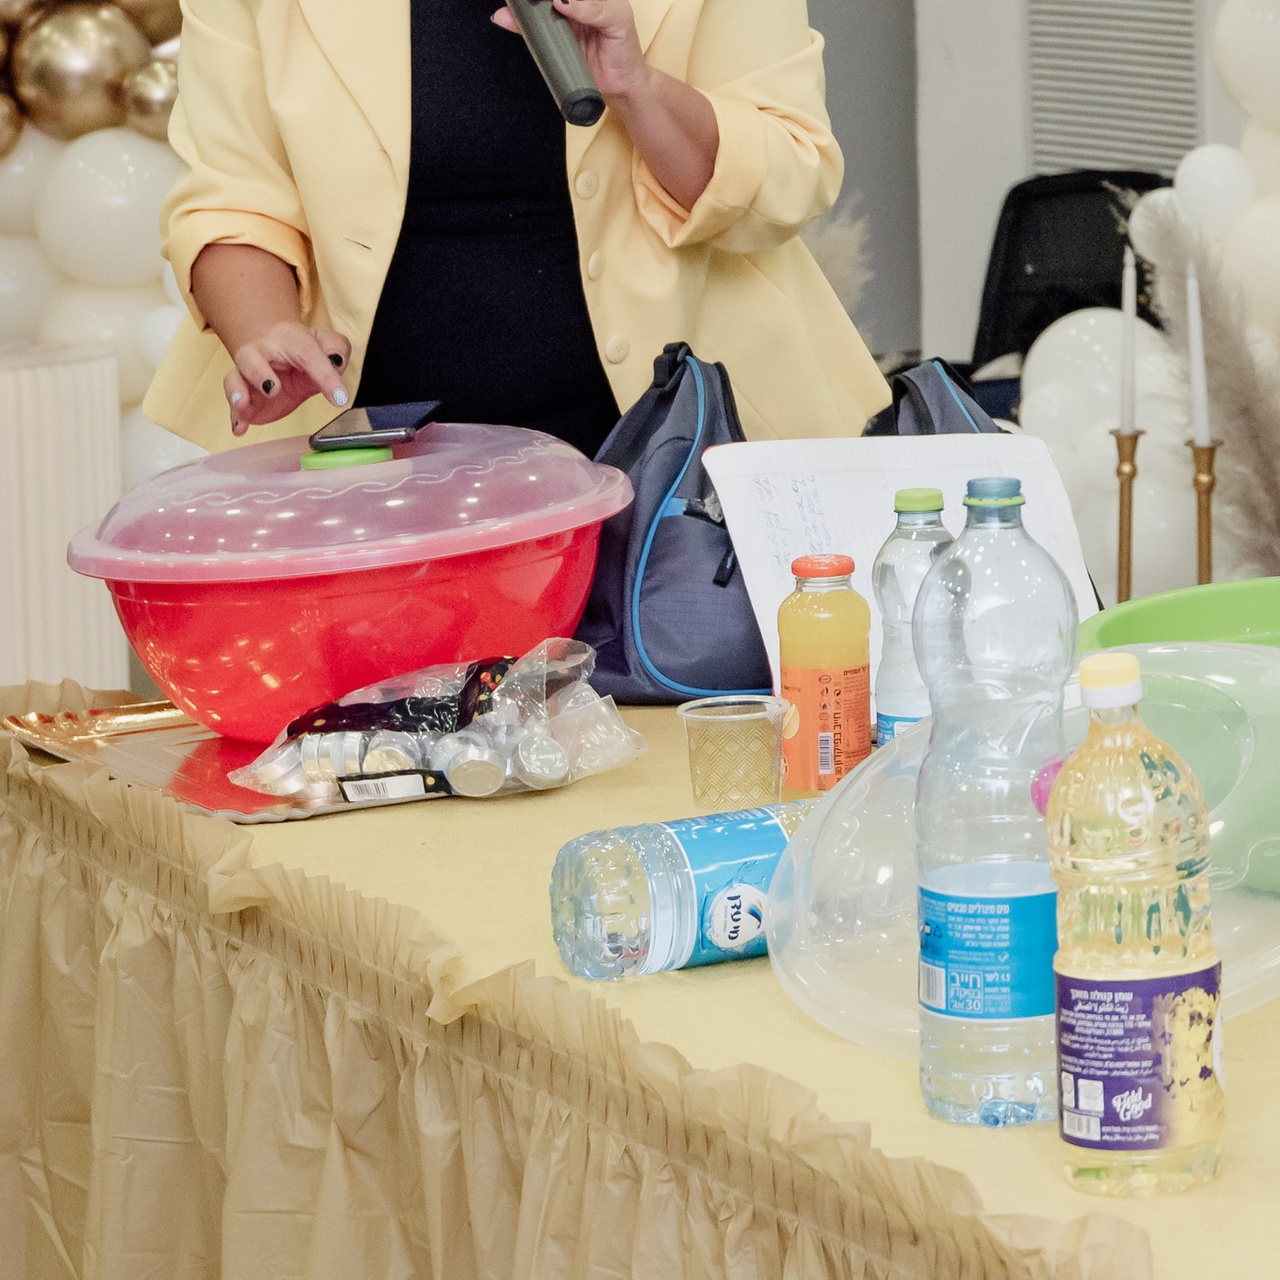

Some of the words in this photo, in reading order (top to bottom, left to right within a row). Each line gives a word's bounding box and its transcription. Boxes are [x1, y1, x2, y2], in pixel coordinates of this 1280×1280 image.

[833, 712, 842, 730] חייב
[726, 894, 742, 923] עדן
[728, 925, 740, 941] מי
[950, 971, 981, 988] חייב
[950, 987, 981, 1000] בפיקדון
[965, 999, 981, 1011] 30
